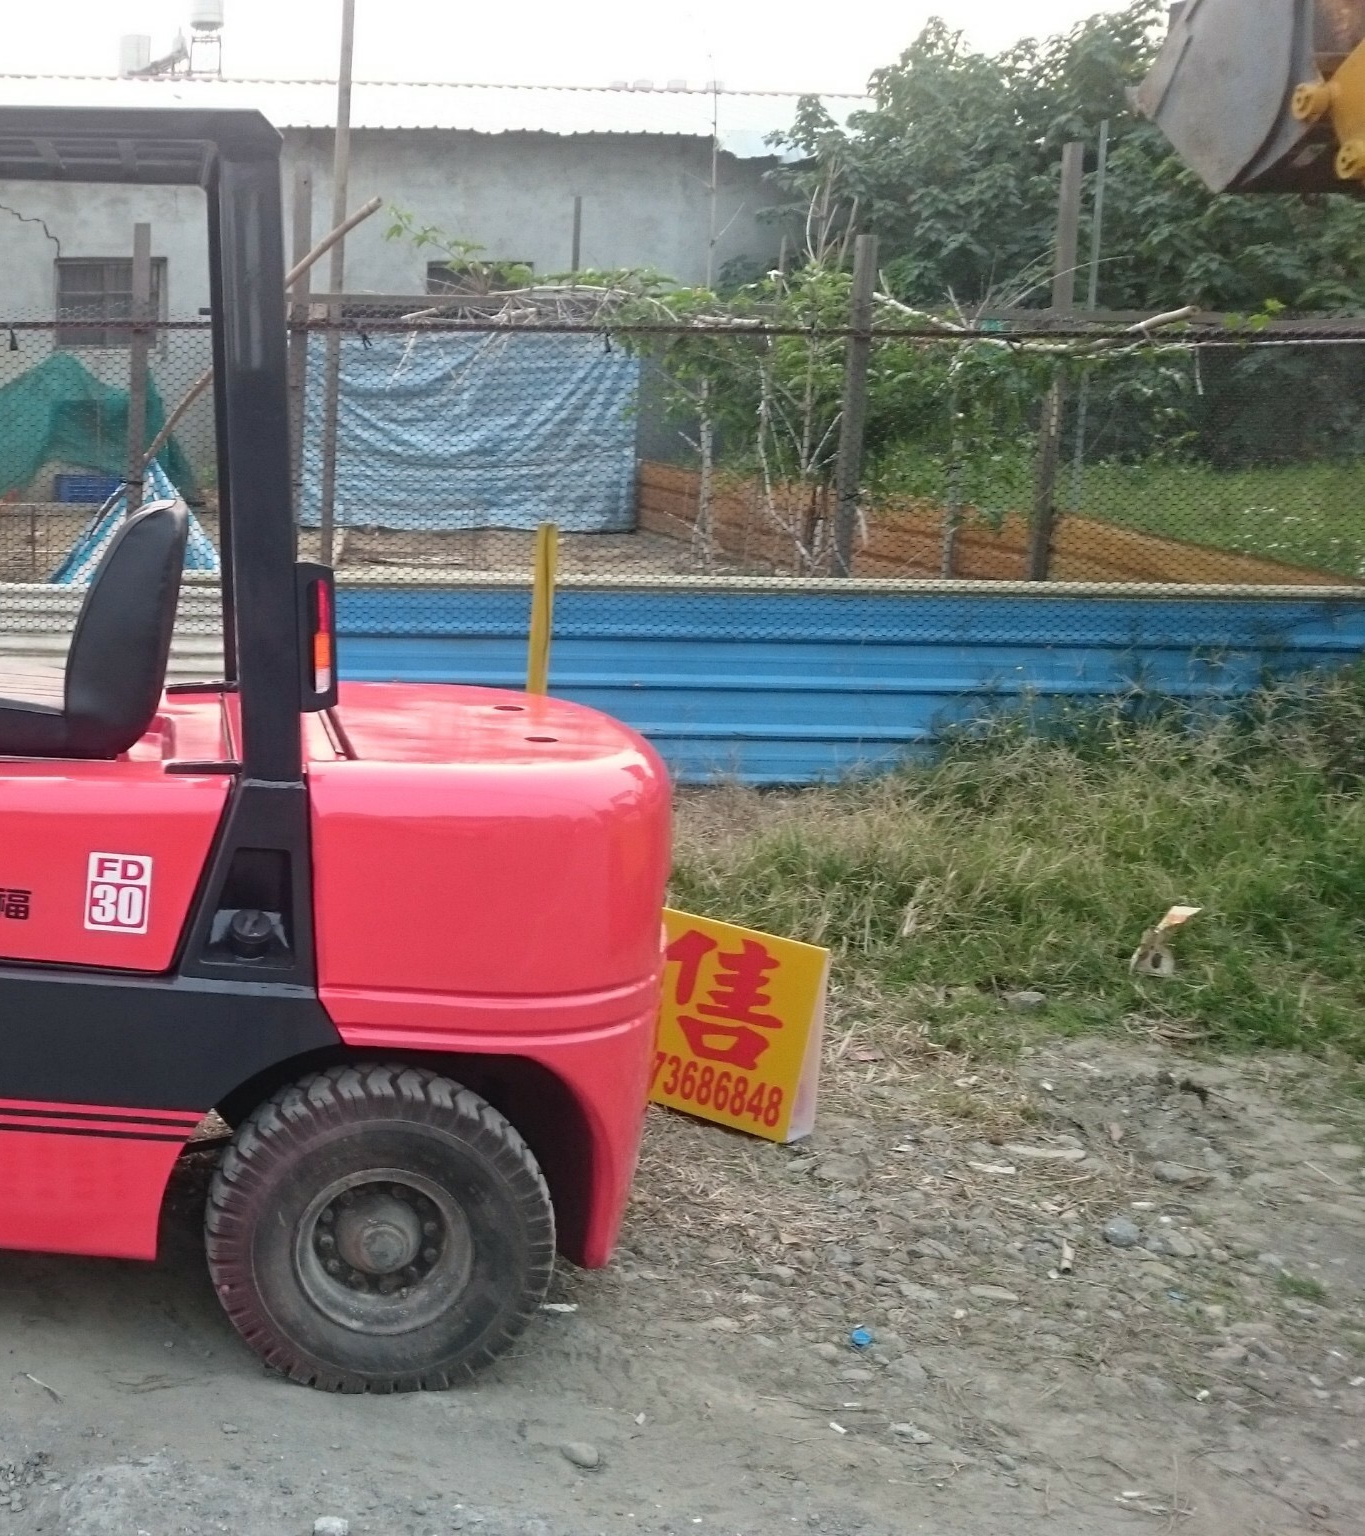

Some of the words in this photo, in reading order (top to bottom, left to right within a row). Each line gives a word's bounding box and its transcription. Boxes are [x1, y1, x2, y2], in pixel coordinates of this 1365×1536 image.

[96, 857, 144, 881] FD
[90, 884, 144, 925] 30
[666, 929, 784, 1071] 售
